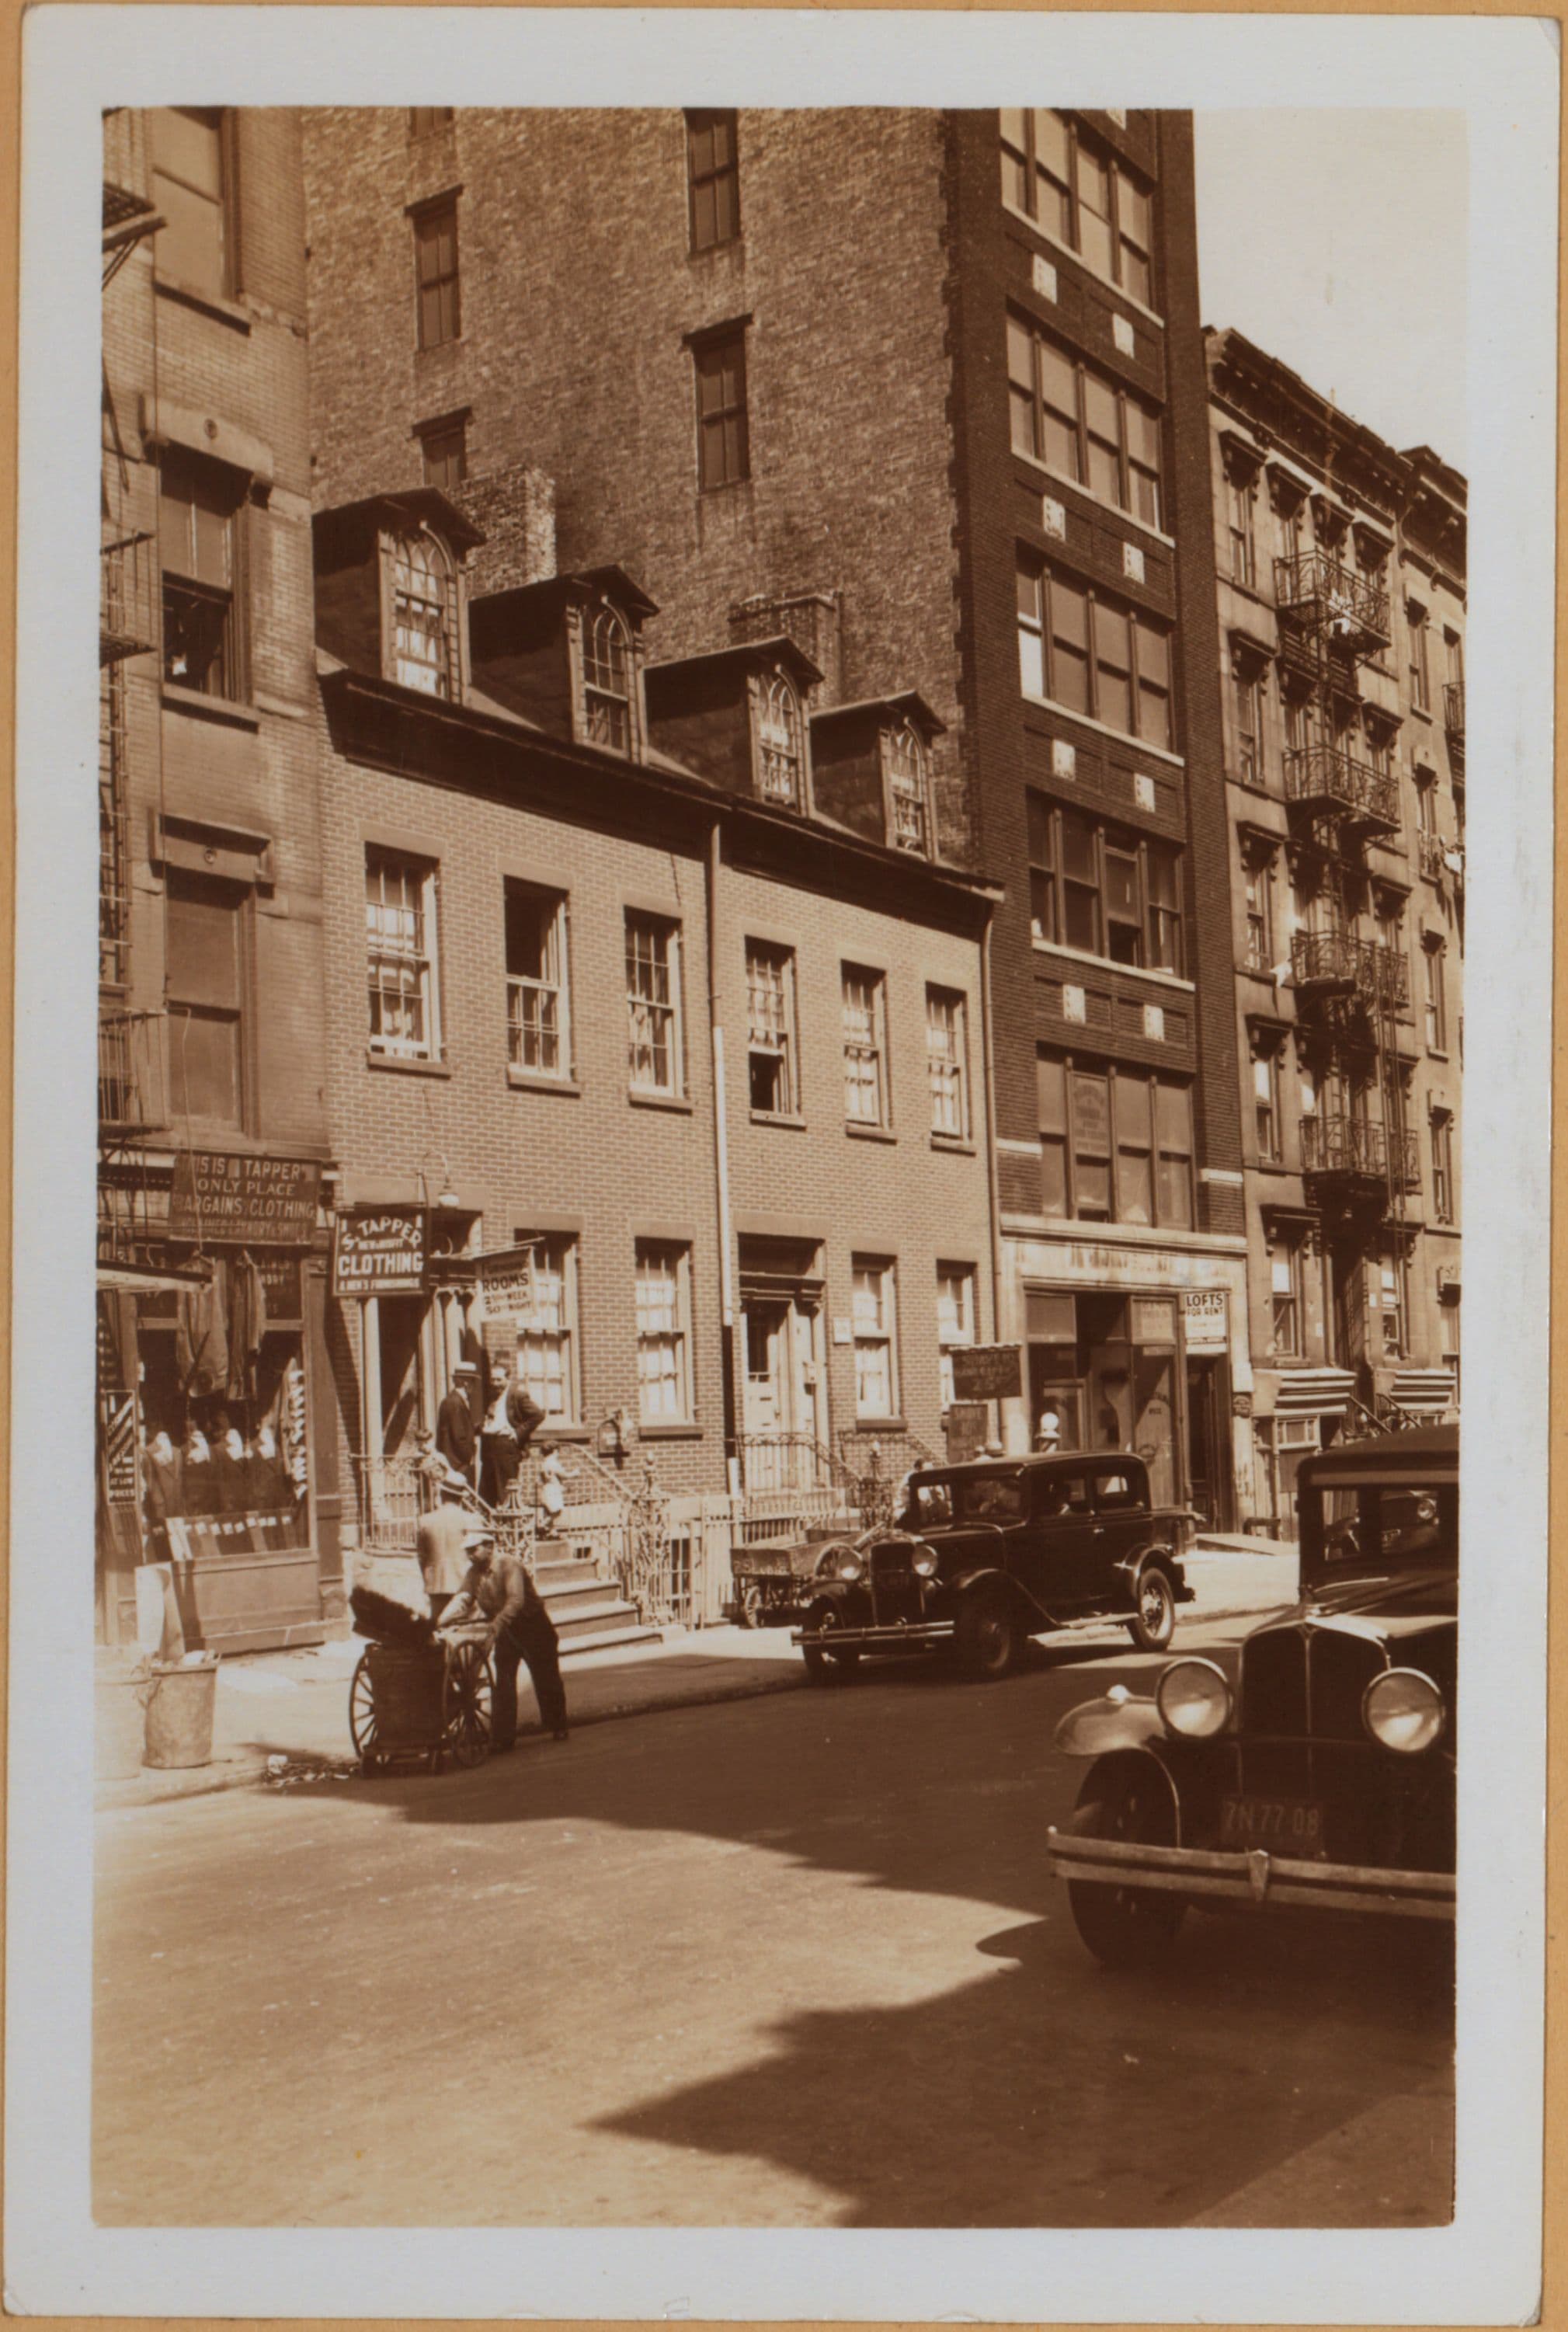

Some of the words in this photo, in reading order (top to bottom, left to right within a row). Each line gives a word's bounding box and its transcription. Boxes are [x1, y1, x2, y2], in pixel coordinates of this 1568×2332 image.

[197, 1178, 241, 1194] ONLY
[246, 1181, 297, 1196] PLACE
[357, 1216, 423, 1250] TAPPER
[338, 1251, 424, 1276] CLOTHING
[482, 1273, 530, 1293] ROOMS
[1186, 1293, 1223, 1307] LOFTS
[1187, 1308, 1201, 1317] FOR
[1205, 1307, 1223, 1316] RENT
